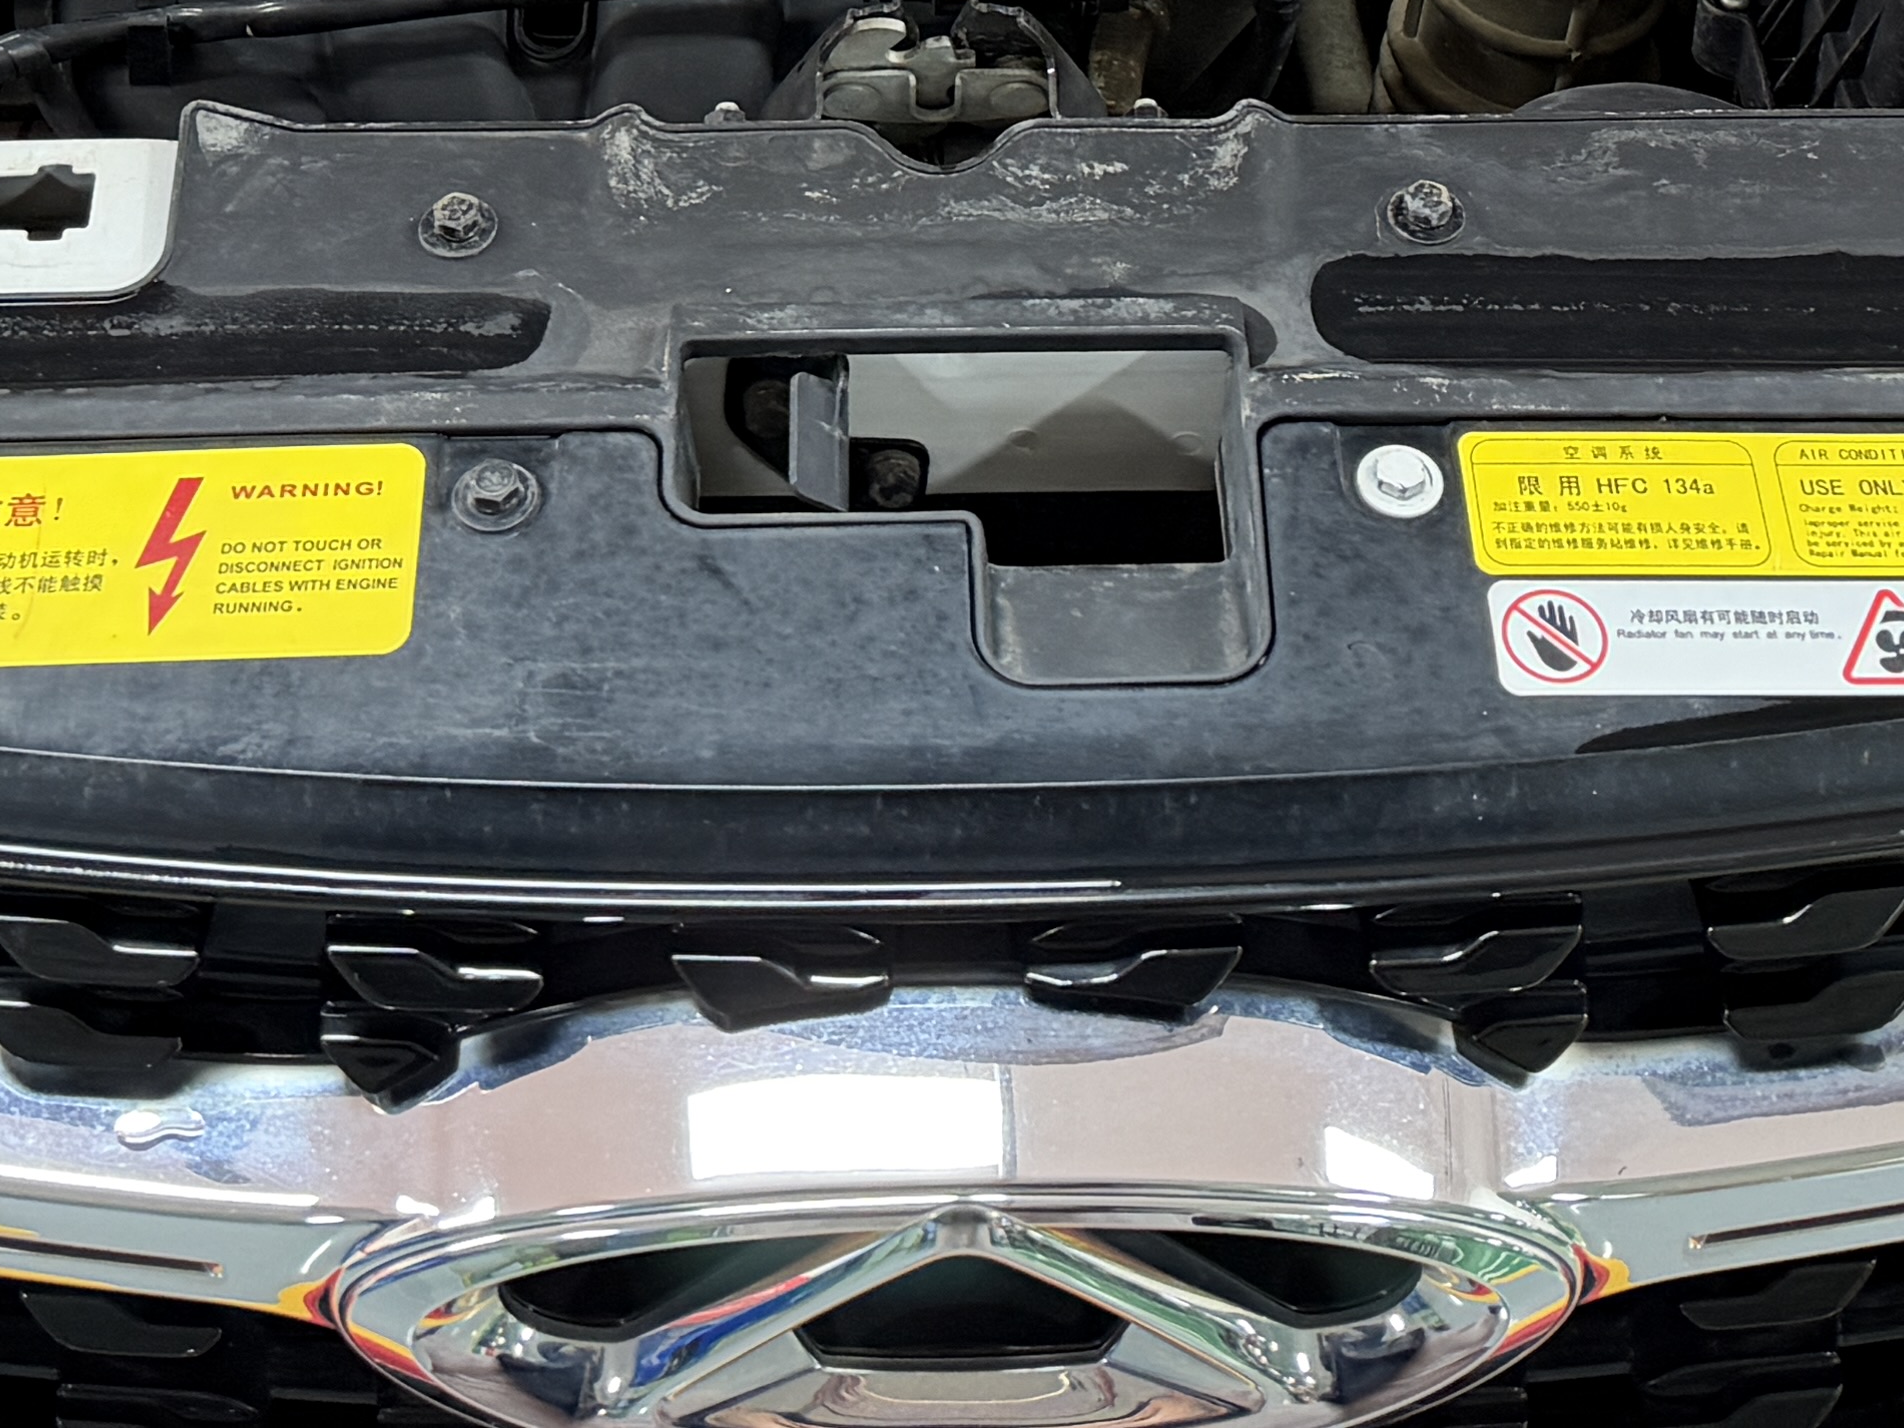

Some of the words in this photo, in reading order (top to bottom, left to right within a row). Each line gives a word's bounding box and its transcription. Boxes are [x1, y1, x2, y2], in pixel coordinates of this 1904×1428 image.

[1563, 446, 1663, 460] 空调系统
[1799, 449, 1829, 460] AIR
[231, 480, 383, 499] WARNING!
[1596, 478, 1648, 495] HFC
[1665, 478, 1715, 495] 134a
[1800, 479, 1844, 496] USE
[1799, 503, 1842, 514] Charge
[221, 542, 246, 554] DO
[251, 541, 287, 553] NOT
[293, 539, 352, 552] TOUCH
[357, 538, 382, 550] OR
[218, 559, 325, 574] DISCONNECT
[333, 557, 403, 571] IGNITION
[215, 580, 284, 594] CABLES
[289, 579, 331, 591] WITH
[336, 577, 399, 590] ENGINE
[213, 600, 302, 614] RUNNING.
[1630, 608, 1820, 625] 冷却风扇有可能随时启动
[1616, 629, 1667, 639] Radiator
[1674, 629, 1693, 639] fan
[1700, 630, 1725, 641] may
[1732, 629, 1759, 639] start
[1766, 629, 1778, 639] at
[1785, 630, 1806, 641] any
